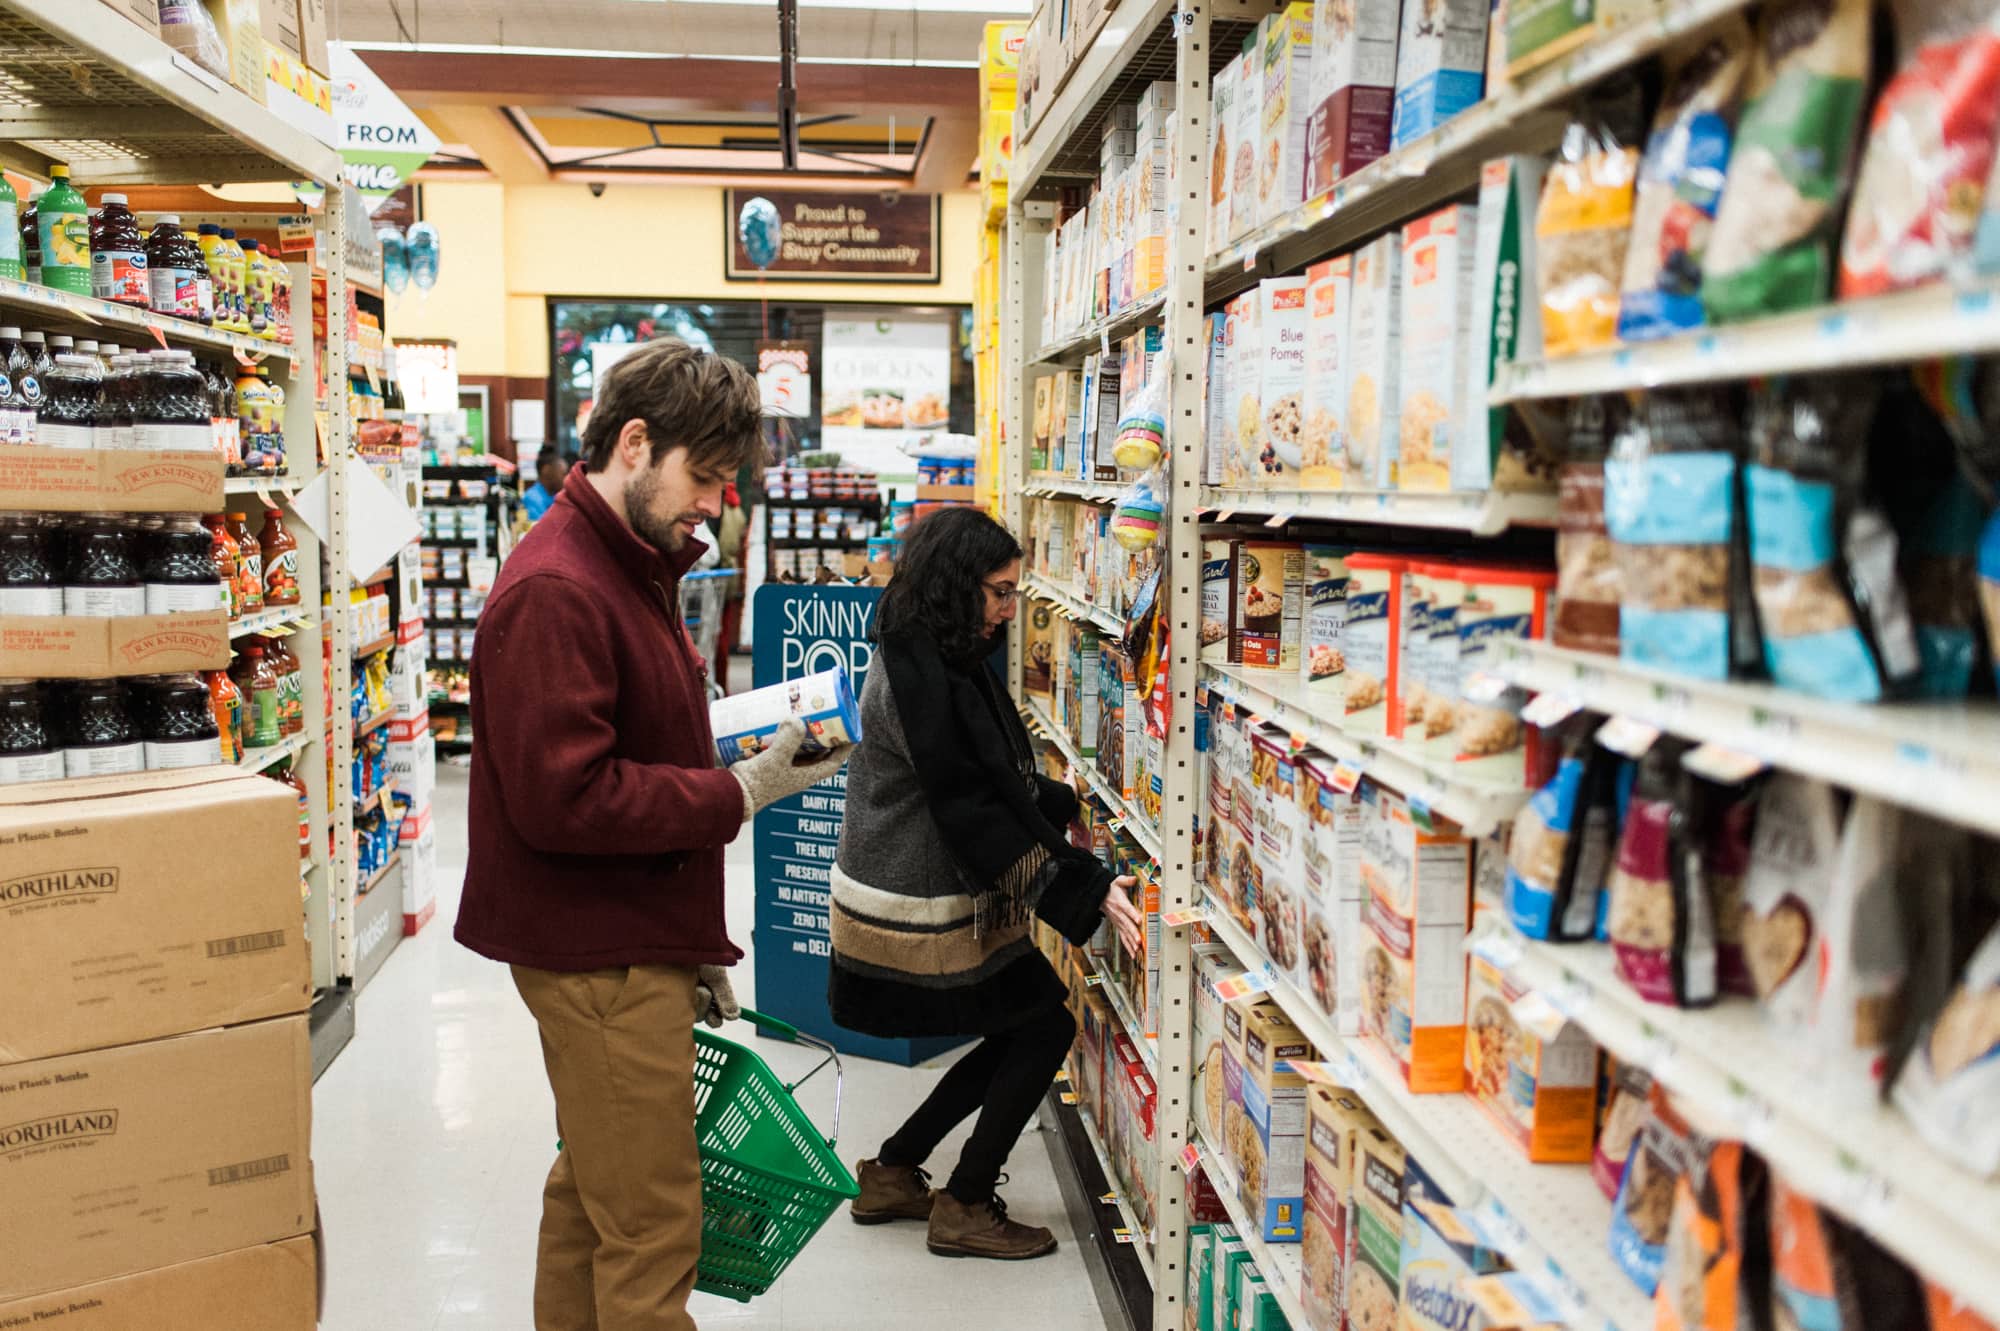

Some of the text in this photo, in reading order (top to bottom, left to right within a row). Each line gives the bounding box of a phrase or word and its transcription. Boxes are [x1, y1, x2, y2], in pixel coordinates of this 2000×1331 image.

[347, 125, 417, 144] FROM
[795, 203, 867, 223] Proud to
[782, 222, 880, 245] Support the
[823, 242, 920, 266] Community
[1281, 328, 1303, 342] Blue
[782, 638, 873, 697] POP
[802, 795, 829, 811] DAIRY
[18, 832, 50, 843] Plastic
[54, 826, 89, 838] Bottles
[798, 818, 833, 836] PEANUT
[795, 841, 837, 860] TREE NUT
[778, 886, 791, 900] NO
[793, 911, 816, 929] ZERO
[792, 941, 808, 953] AND
[19, 1078, 51, 1090] Plastic
[55, 1071, 89, 1083] Bottles
[33, 1307, 65, 1320] Plastic
[68, 1298, 103, 1313] Bottles
